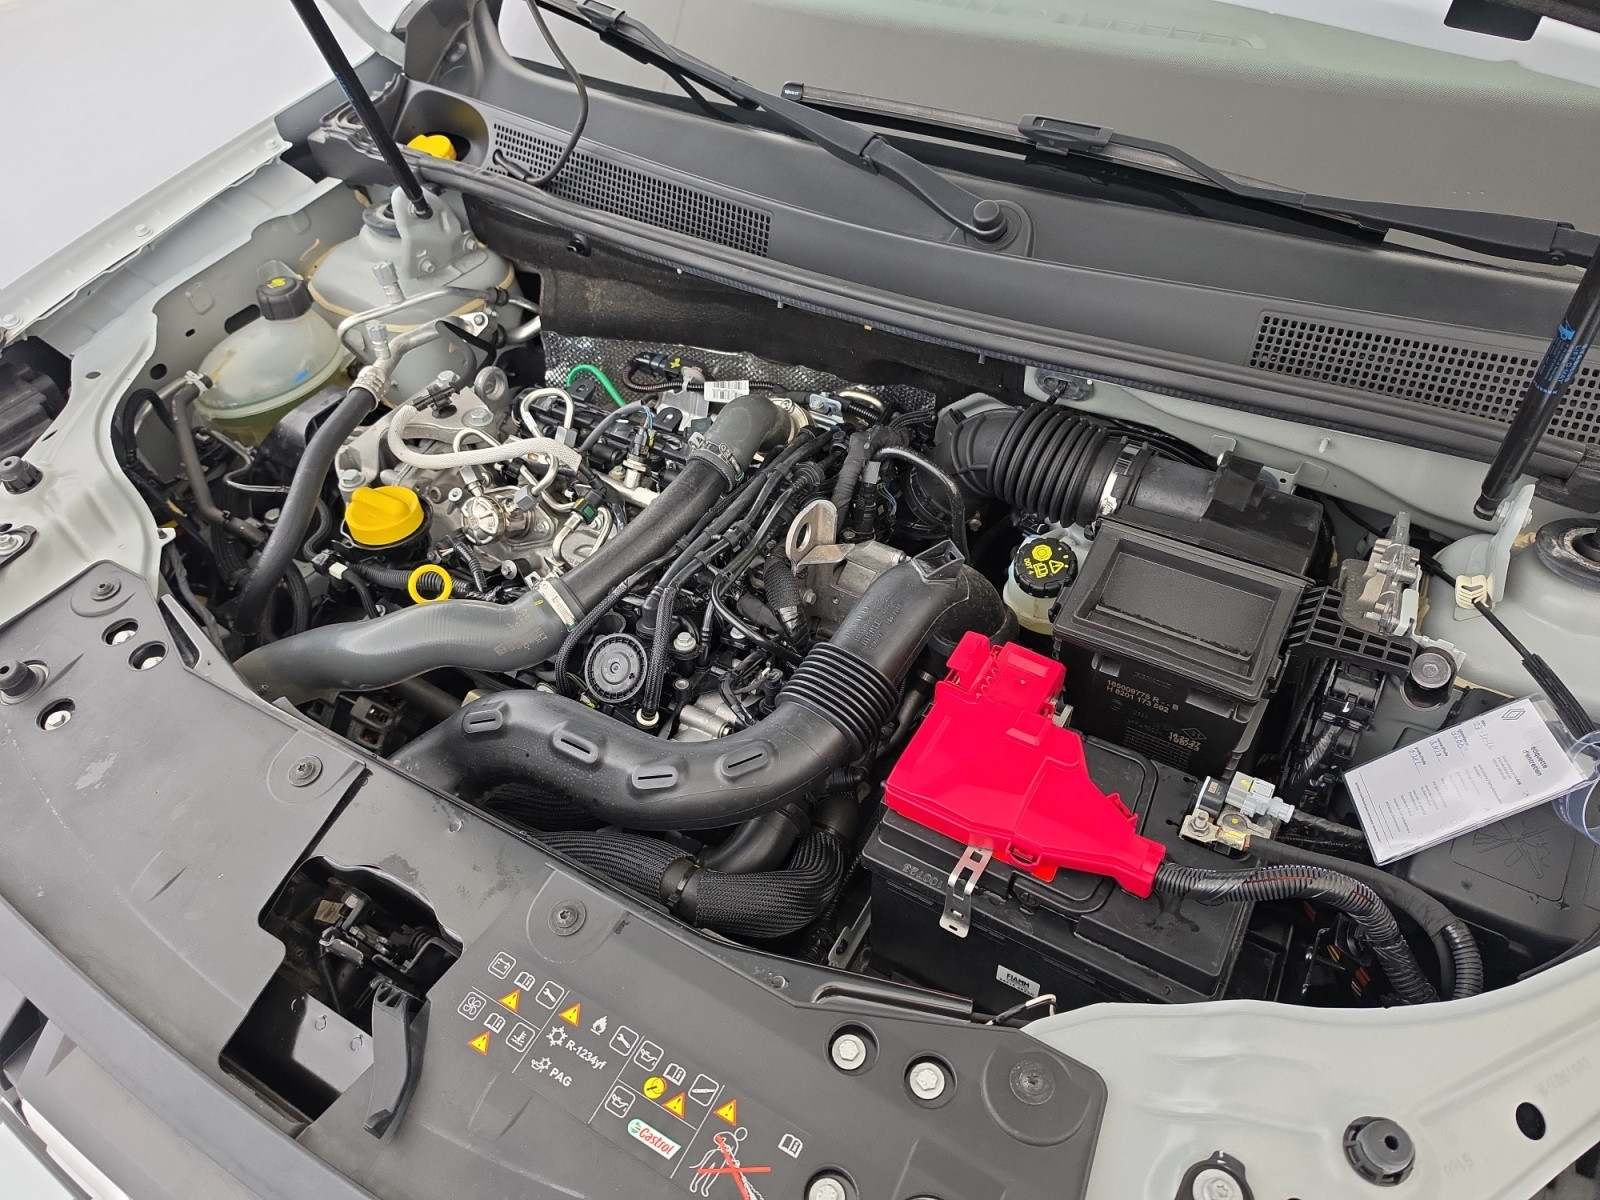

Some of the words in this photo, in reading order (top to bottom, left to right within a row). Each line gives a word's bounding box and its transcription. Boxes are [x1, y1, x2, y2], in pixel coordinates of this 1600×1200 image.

[1023, 557, 1033, 569] DOT
[1138, 697, 1152, 707] 173
[1006, 973, 1030, 989] FIAMM
[565, 1040, 607, 1070] R-1234yf
[549, 1067, 573, 1087] PAG
[639, 1127, 675, 1156] Castrol
